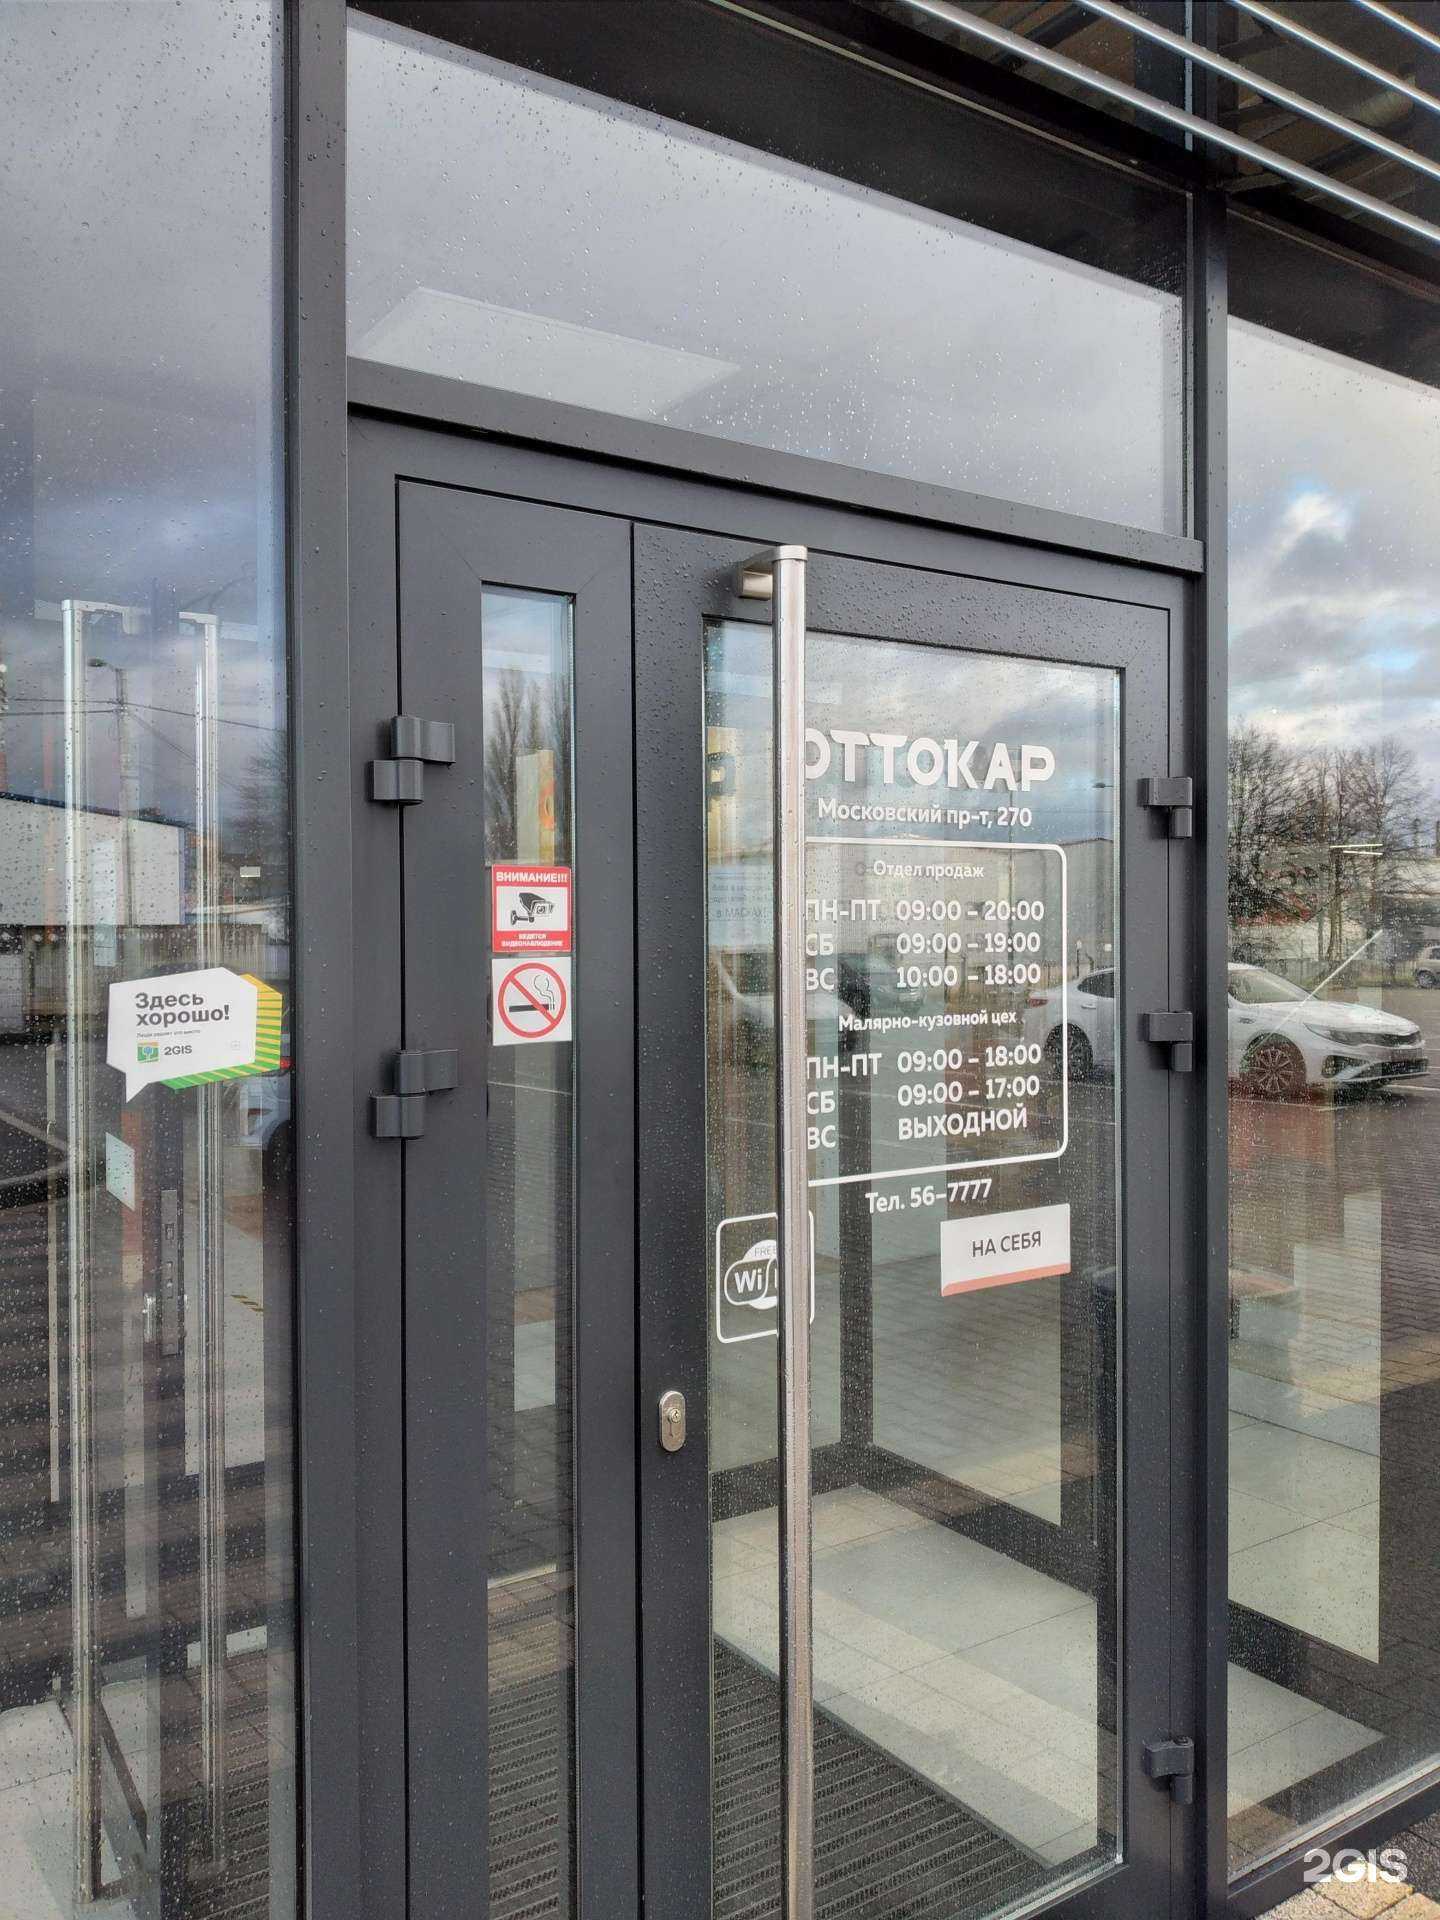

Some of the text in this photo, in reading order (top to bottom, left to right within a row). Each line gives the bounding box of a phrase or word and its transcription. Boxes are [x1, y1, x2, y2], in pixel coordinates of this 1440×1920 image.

[804, 728, 1056, 791] ОТТОКАР
[817, 797, 1032, 829] Московский пр-т, 270
[495, 871, 568, 883] ВНИМАНИЕ!!!
[873, 860, 985, 880] Отдел продаж
[805, 899, 881, 921] ПН-ПТ
[896, 900, 962, 921] 09:00
[984, 900, 1045, 921] 20:00
[805, 933, 834, 956] СБ
[896, 932, 962, 953] 09:00
[984, 932, 1041, 953] 19:00
[806, 967, 835, 991] ВС
[896, 966, 958, 988] 10:00
[984, 964, 1041, 986] 18:00
[135, 992, 204, 1011] Здесь
[136, 1004, 230, 1028] хорошо!
[838, 1009, 1017, 1033] Малярно-кузовной цех
[164, 1045, 193, 1056] 2GIS
[806, 1053, 882, 1079] ПН-ПТ
[897, 1049, 963, 1074] 09:00
[985, 1044, 1042, 1068] 18:00
[807, 1090, 836, 1114] СБ
[898, 1080, 963, 1106] 09:00
[985, 1076, 1040, 1099] 17:00
[807, 1103, 1028, 1150] ВС ВЫХОДНОЙ
[865, 1178, 993, 1215] Тел. 56-7777
[972, 1230, 1042, 1257] НА СЕБЯ
